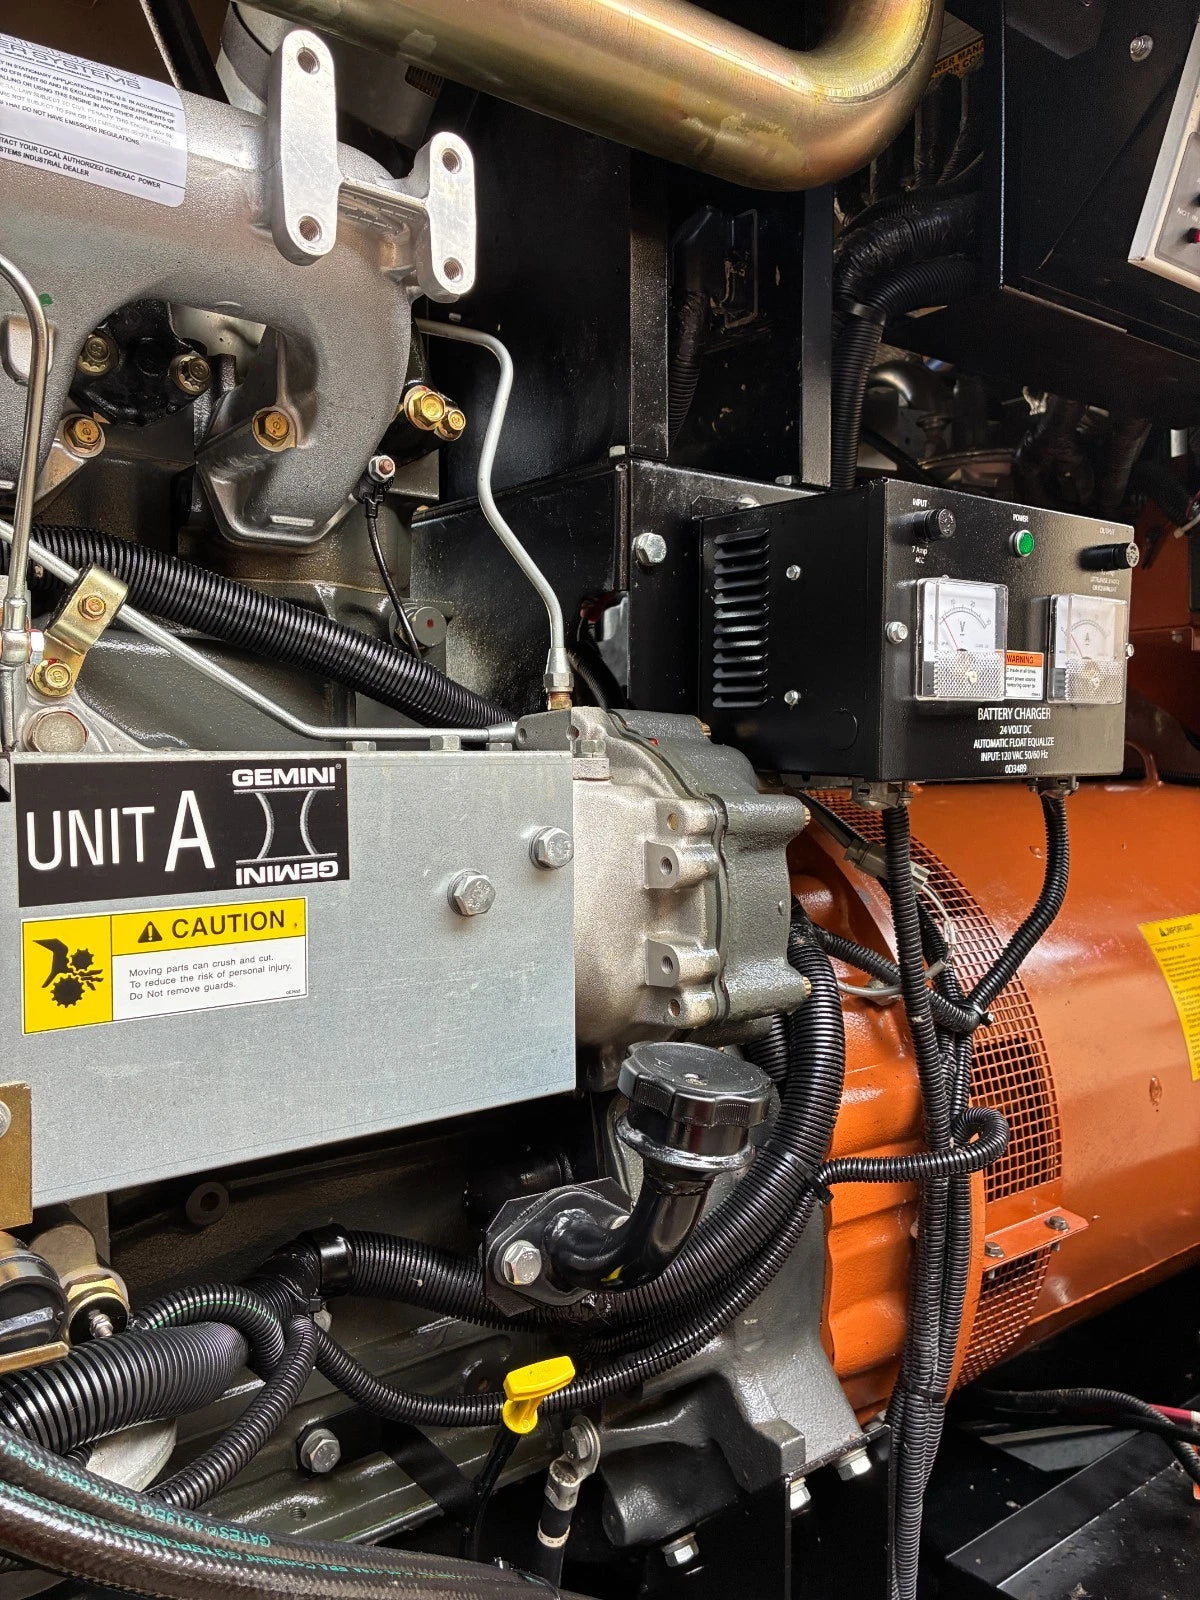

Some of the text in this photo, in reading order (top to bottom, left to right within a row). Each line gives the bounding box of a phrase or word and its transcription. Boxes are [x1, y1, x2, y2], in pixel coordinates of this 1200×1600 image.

[30, 50, 141, 89] SYSTEMS
[32, 108, 46, 116] NOT
[46, 113, 64, 122] HAVE
[64, 118, 98, 132] EMISSIONS
[18, 142, 38, 152] YOUR
[38, 148, 62, 159] LOCAL
[62, 155, 104, 172] AUTHORIZED
[104, 167, 135, 181] GENERAC
[137, 177, 161, 189] POWER
[22, 152, 61, 168] INDUSTRIAL
[62, 164, 90, 177] DEALER
[912, 498, 928, 508] INPUT
[1012, 514, 1029, 522] POWER
[1100, 527, 1115, 536] OUTPUT
[1006, 654, 1034, 664] WARNING
[978, 708, 1050, 720] BATTERY CHARGER
[1000, 725, 1032, 734] 24 VOLT DC
[974, 737, 1054, 748] AUTOMATIC FLOAT EQUALIZE
[1001, 752, 1012, 760] 120
[1012, 751, 1024, 760] VAC
[1024, 750, 1040, 760] 50/60
[1041, 750, 1048, 758] Hz
[26, 790, 216, 872] UNIT A
[236, 860, 338, 886] GEMINI
[172, 910, 285, 938] CAUTION
[129, 968, 162, 977] Moving
[166, 964, 188, 974] parts
[212, 958, 236, 968] crush
[240, 956, 255, 964] and
[259, 954, 273, 962] cut.
[145, 977, 176, 986] reduce
[198, 972, 213, 980] risk
[229, 966, 265, 978] personal
[268, 963, 292, 973] injury.
[147, 989, 163, 998] Not
[167, 986, 200, 995] remove
[204, 981, 236, 992] guards.
[4, 1440, 42, 1470] Fuel
